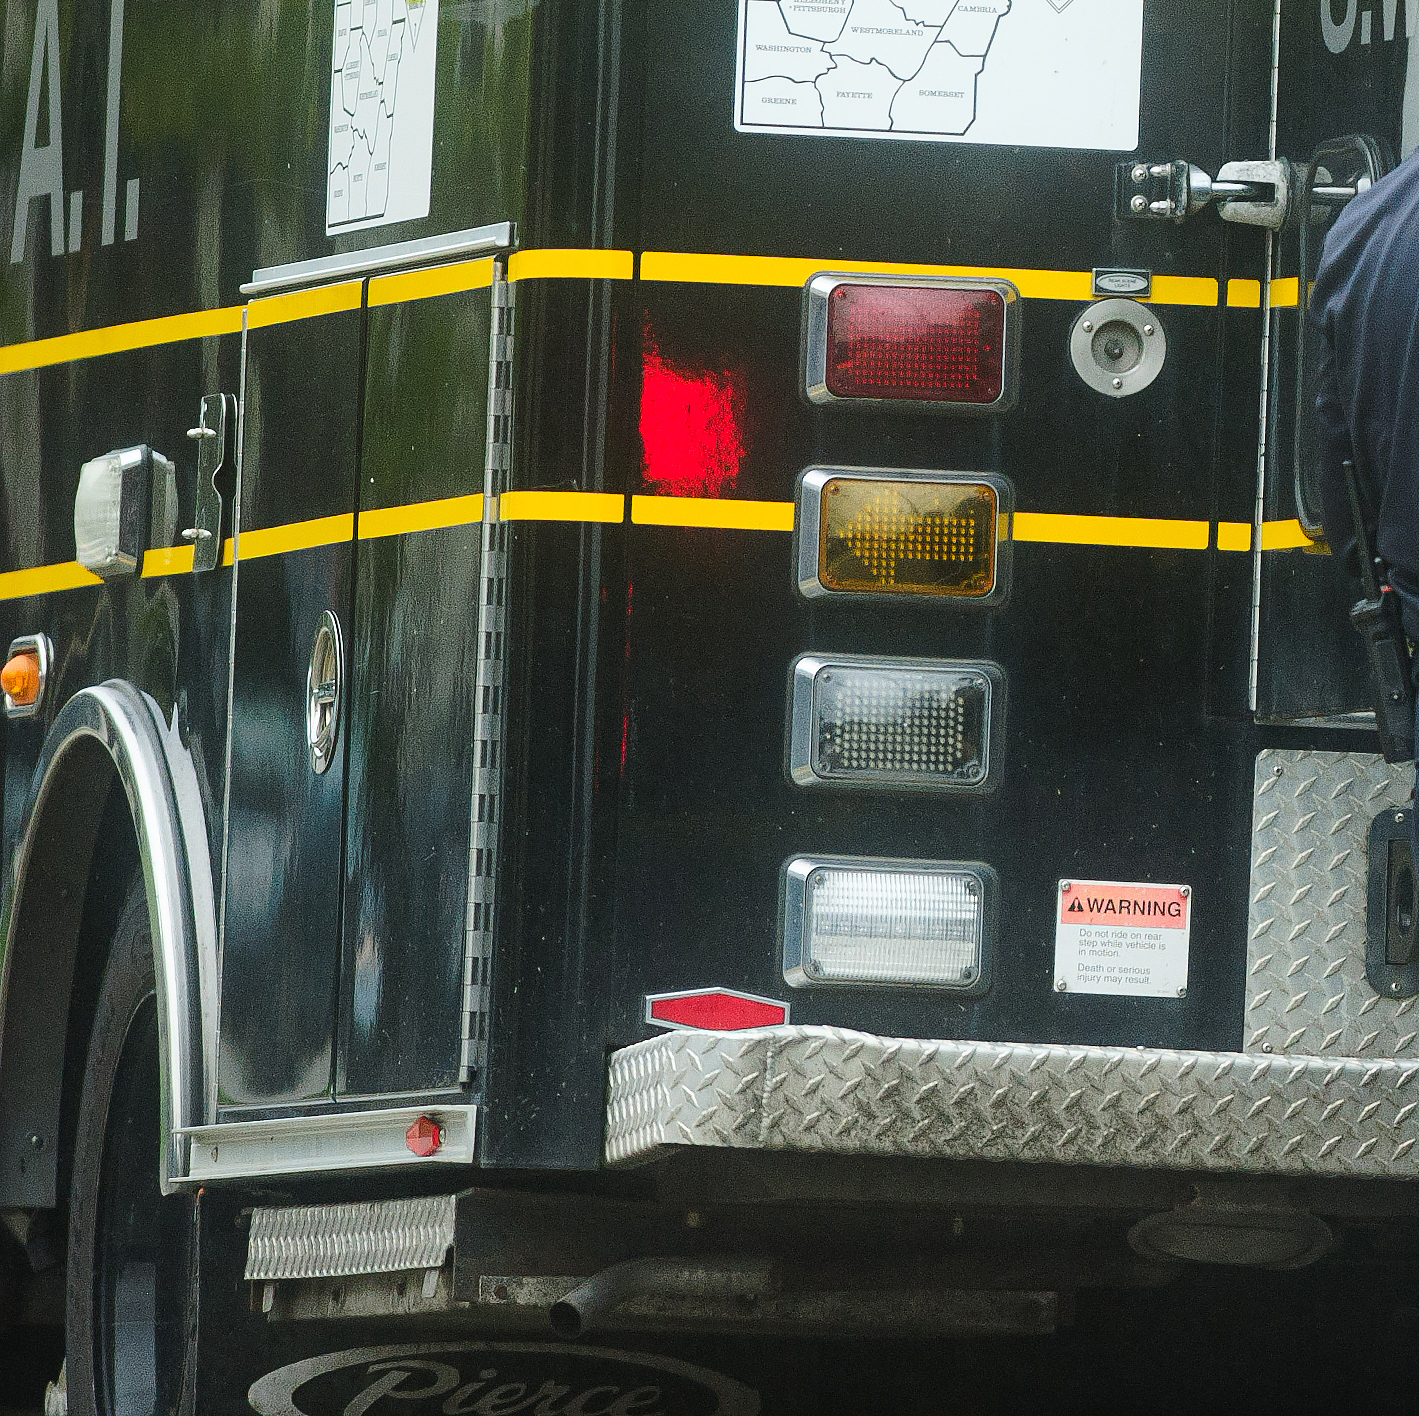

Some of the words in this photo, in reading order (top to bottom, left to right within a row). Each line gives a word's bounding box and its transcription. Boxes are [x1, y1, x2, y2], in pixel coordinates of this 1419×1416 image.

[793, 5, 846, 14] PITTSBURGH
[957, 5, 998, 14] CAMBRIA
[850, 26, 924, 37] WESTMORELAND
[755, 44, 812, 54] WASHINGTON
[836, 90, 873, 100] FAYETTE
[918, 89, 965, 99] SOMERSET
[761, 96, 797, 106] GREENE
[1086, 897, 1182, 918] WARNING
[1079, 928, 1092, 938] Do
[1094, 929, 1109, 938] not
[1111, 930, 1128, 939] ride
[1144, 933, 1163, 941] rear
[1078, 939, 1098, 948] step
[1100, 939, 1123, 948] while
[1125, 941, 1156, 950] vehicle
[1158, 942, 1167, 951] is
[1078, 947, 1087, 956] in
[1077, 962, 1104, 972] Death
[1118, 966, 1151, 975] serious
[1077, 973, 1102, 984] injury
[1103, 975, 1123, 984] may
[343, 1359, 664, 1416] Pierce
